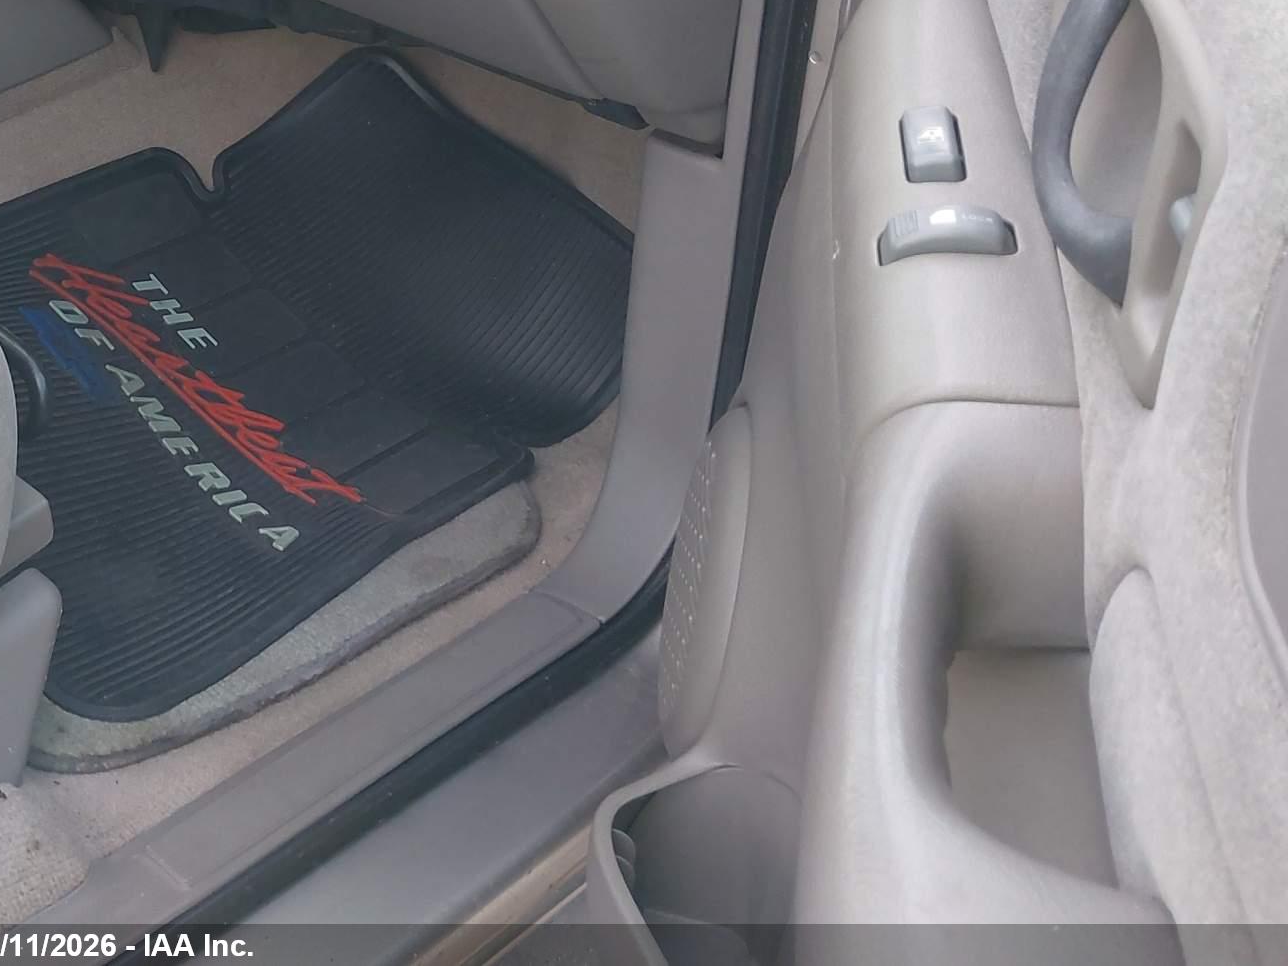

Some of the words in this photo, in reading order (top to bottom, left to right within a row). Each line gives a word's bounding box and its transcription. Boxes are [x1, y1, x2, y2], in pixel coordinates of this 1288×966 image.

[29, 252, 365, 506] Heartbeat
[48, 299, 115, 353] OF
[104, 363, 301, 552] AMERICA
[132, 272, 219, 351] THE
